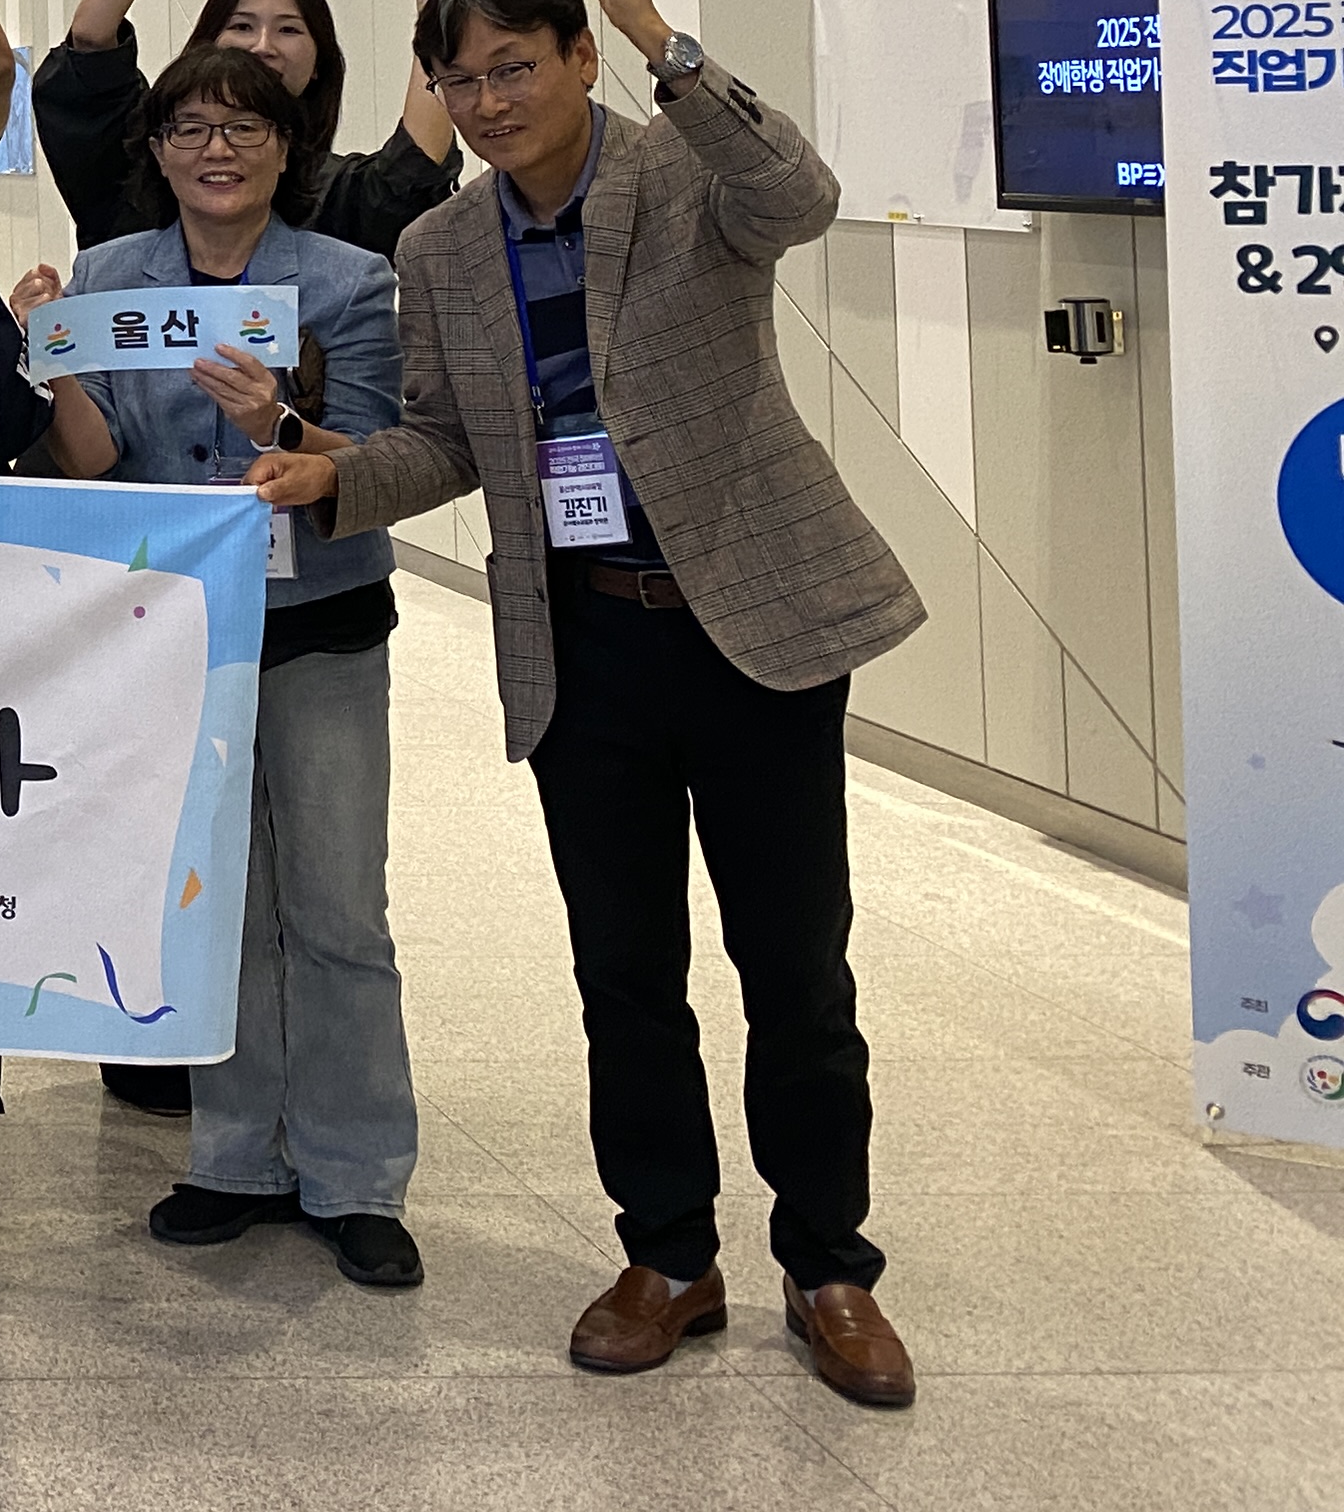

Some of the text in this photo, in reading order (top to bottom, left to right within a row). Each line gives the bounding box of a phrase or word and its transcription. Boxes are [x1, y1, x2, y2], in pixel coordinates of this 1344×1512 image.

[1096, 17, 1141, 48] 2025
[1211, 2, 1334, 40] 2025
[1038, 56, 1162, 94] 장애학생 직업기
[1209, 161, 1344, 225] 참가
[1236, 244, 1283, 294] &
[111, 309, 200, 350] 울산
[558, 495, 608, 519] 김진기
